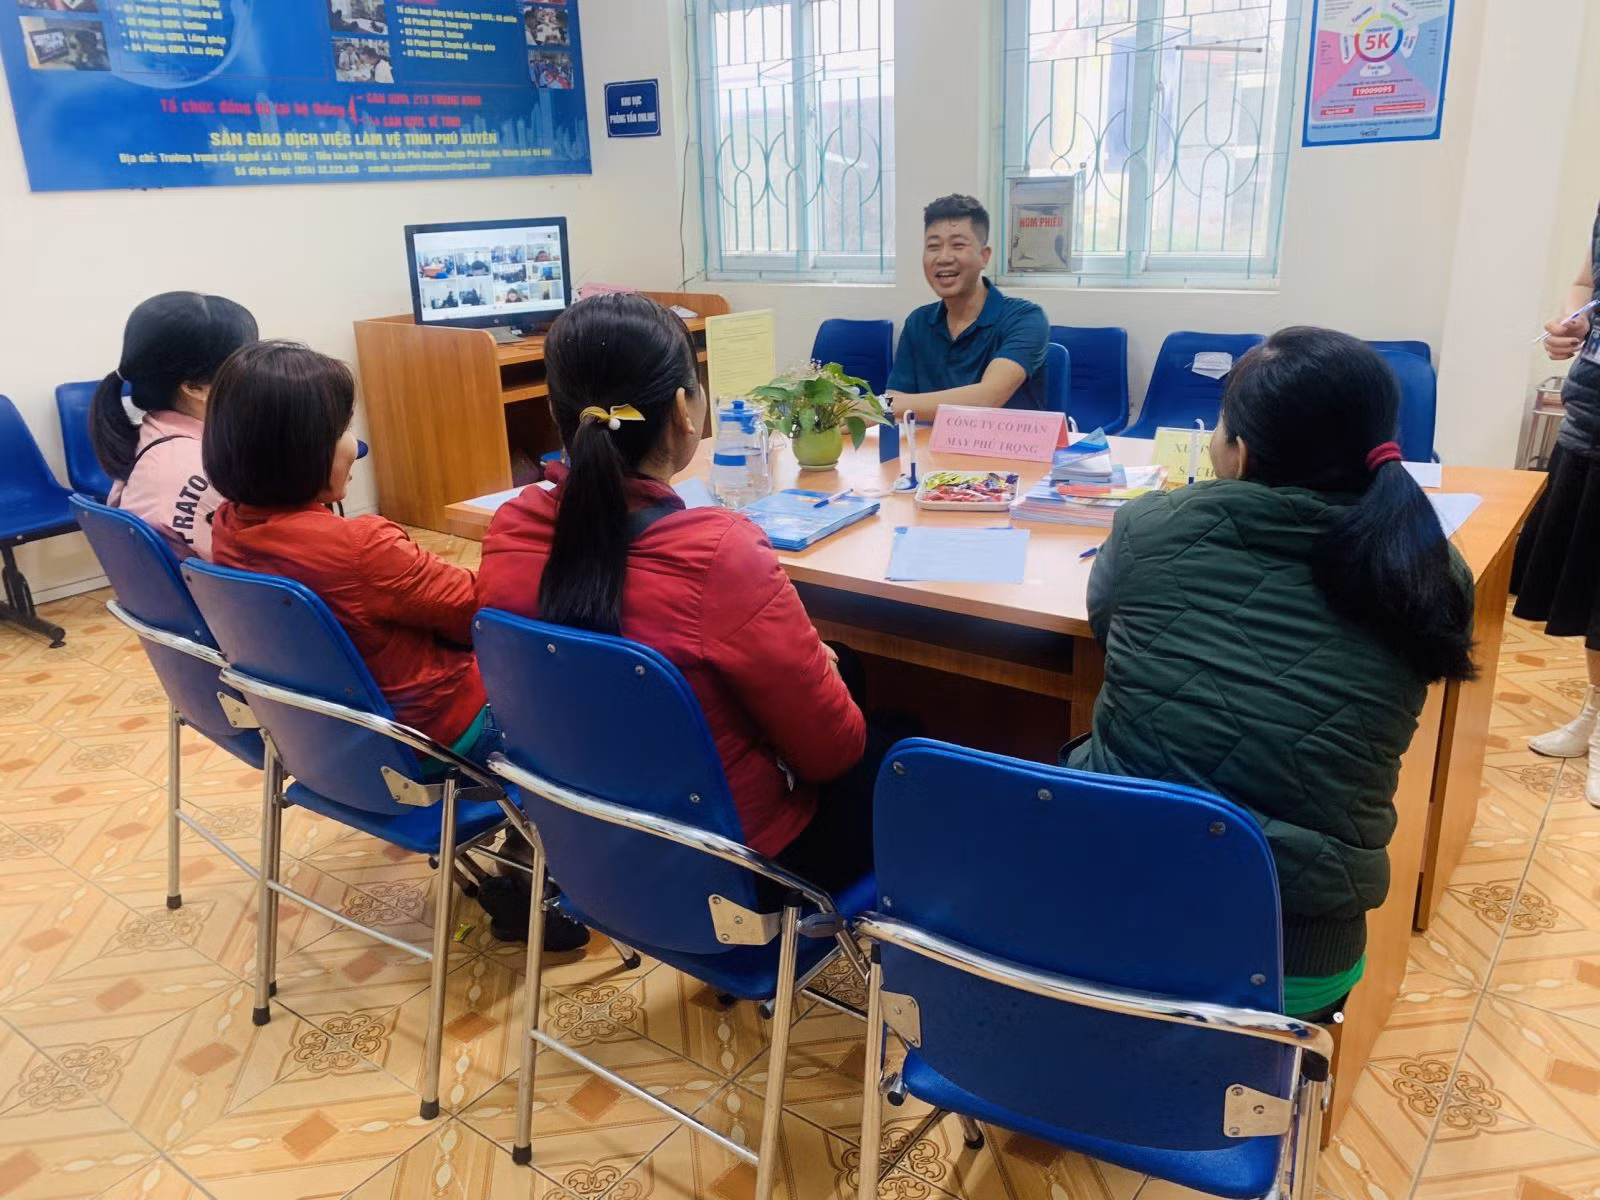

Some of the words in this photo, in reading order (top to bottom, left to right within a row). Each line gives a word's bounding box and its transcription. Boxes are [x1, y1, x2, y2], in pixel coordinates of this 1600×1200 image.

[1365, 32, 1390, 50] 5K
[247, 132, 281, 146] GIAO
[285, 132, 318, 148] DỊCH
[321, 130, 353, 148] VIỆC
[385, 131, 401, 148] VỆ
[404, 133, 433, 146] TINH
[980, 419, 994, 430] TY
[999, 442, 1038, 454] TRỌNG
